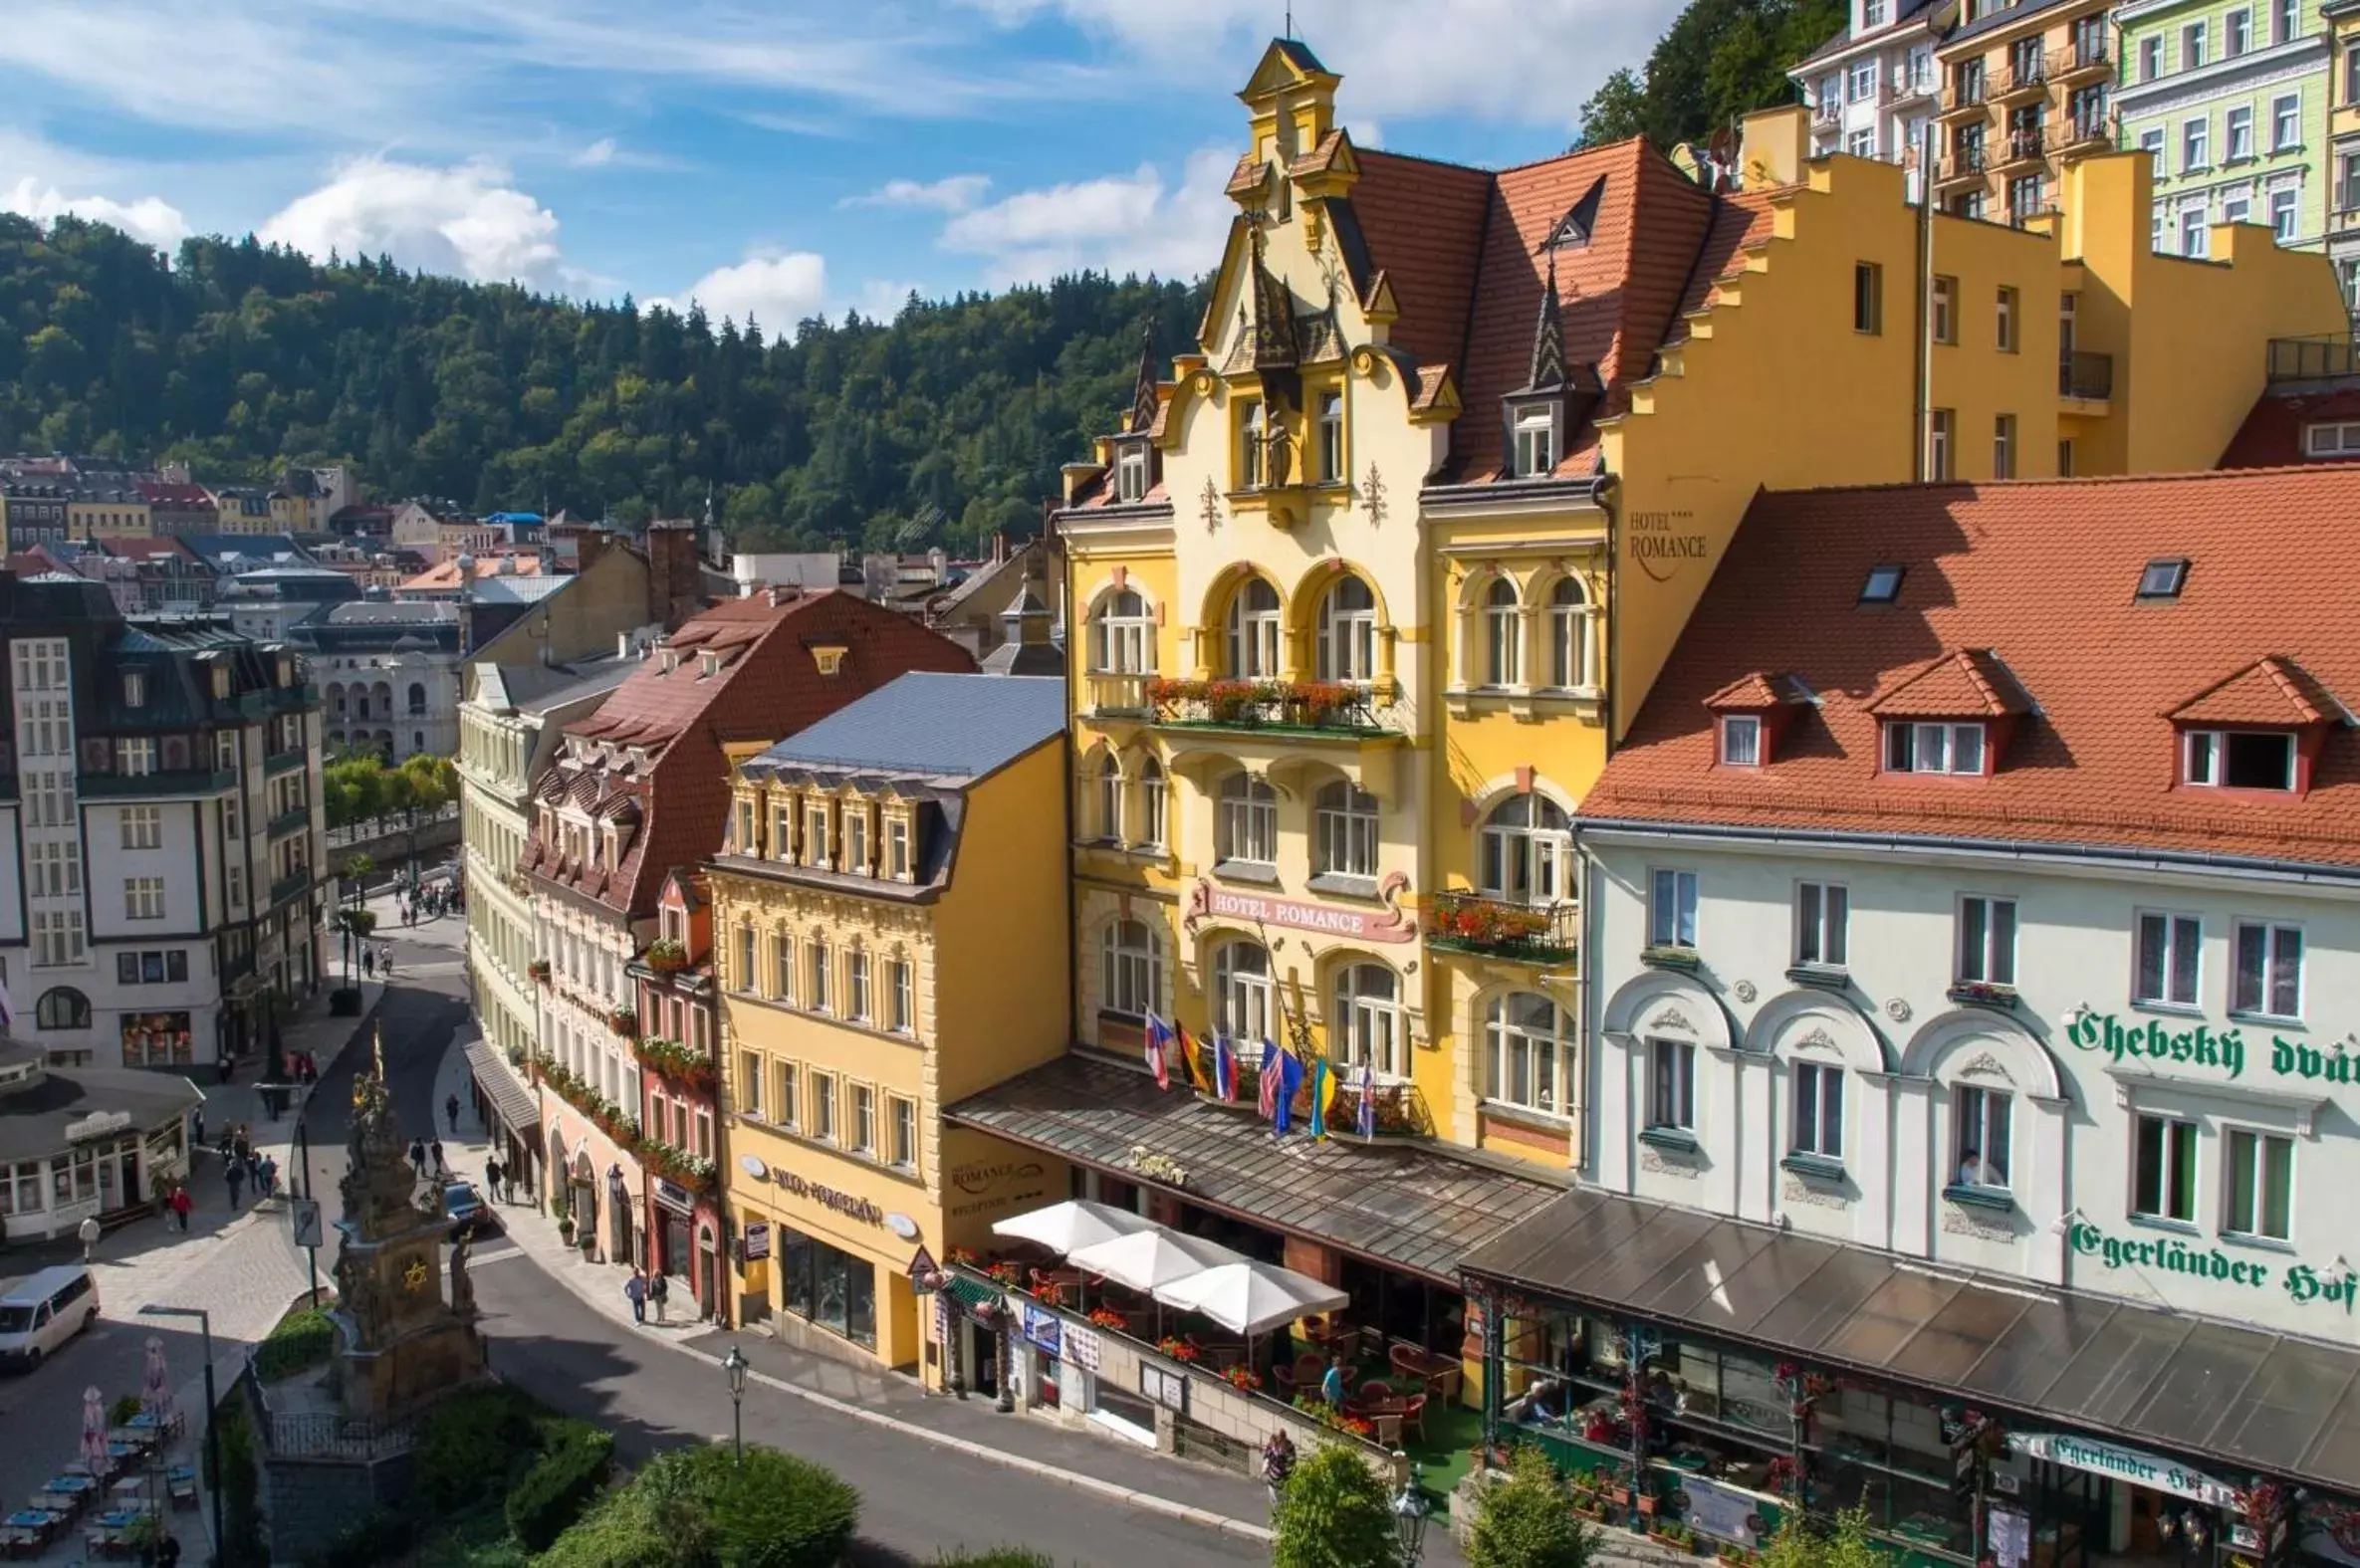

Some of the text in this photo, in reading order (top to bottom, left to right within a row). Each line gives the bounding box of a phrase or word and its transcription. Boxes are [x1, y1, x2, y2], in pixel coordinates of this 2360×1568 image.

[1629, 511, 1671, 532] HOTEL
[1630, 536, 1707, 560] ROMANCE
[1214, 894, 1364, 934] HOTEL ROMANCE
[2066, 1010, 2245, 1079] Chebský
[2070, 1222, 2358, 1316] Egerländer Hof
[2053, 1435, 2204, 1499] Egerländer Hof
